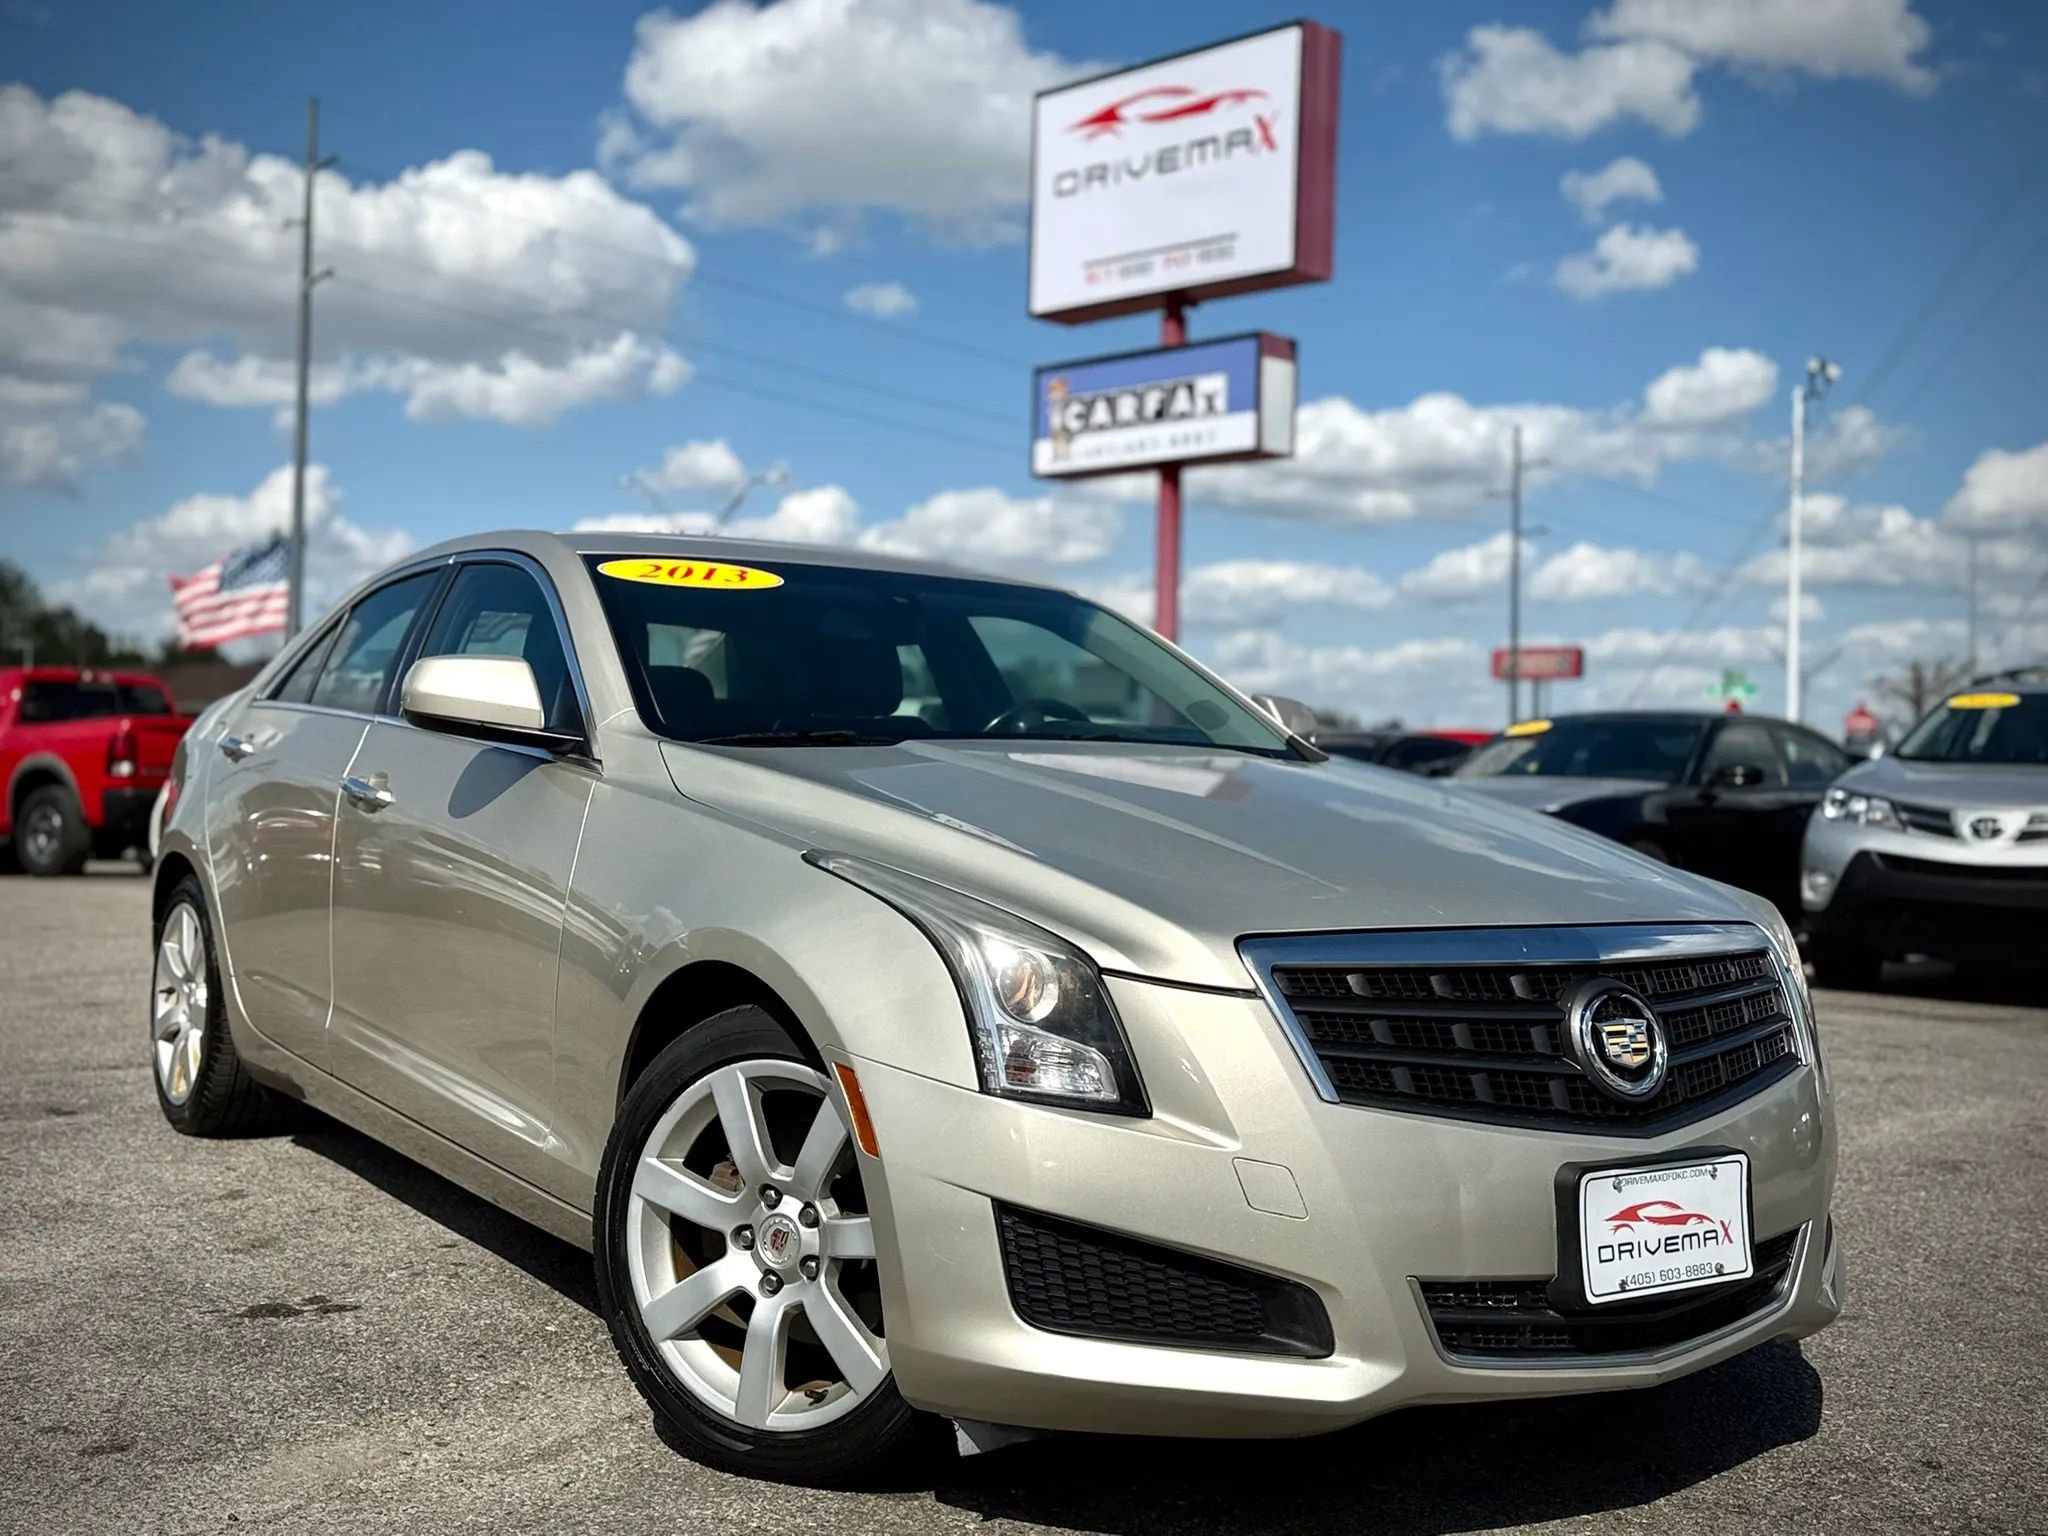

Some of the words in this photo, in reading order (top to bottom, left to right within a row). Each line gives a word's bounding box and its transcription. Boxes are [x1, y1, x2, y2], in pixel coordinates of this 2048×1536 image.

[1052, 110, 1280, 198] DRIVEMAX
[1063, 379, 1221, 434] CARFAX
[637, 564, 748, 584] 2013
[1598, 1219, 1733, 1264] DRIVEMAX
[1625, 1271, 1656, 1288] (405)
[1660, 1262, 1713, 1282] 603-8883
